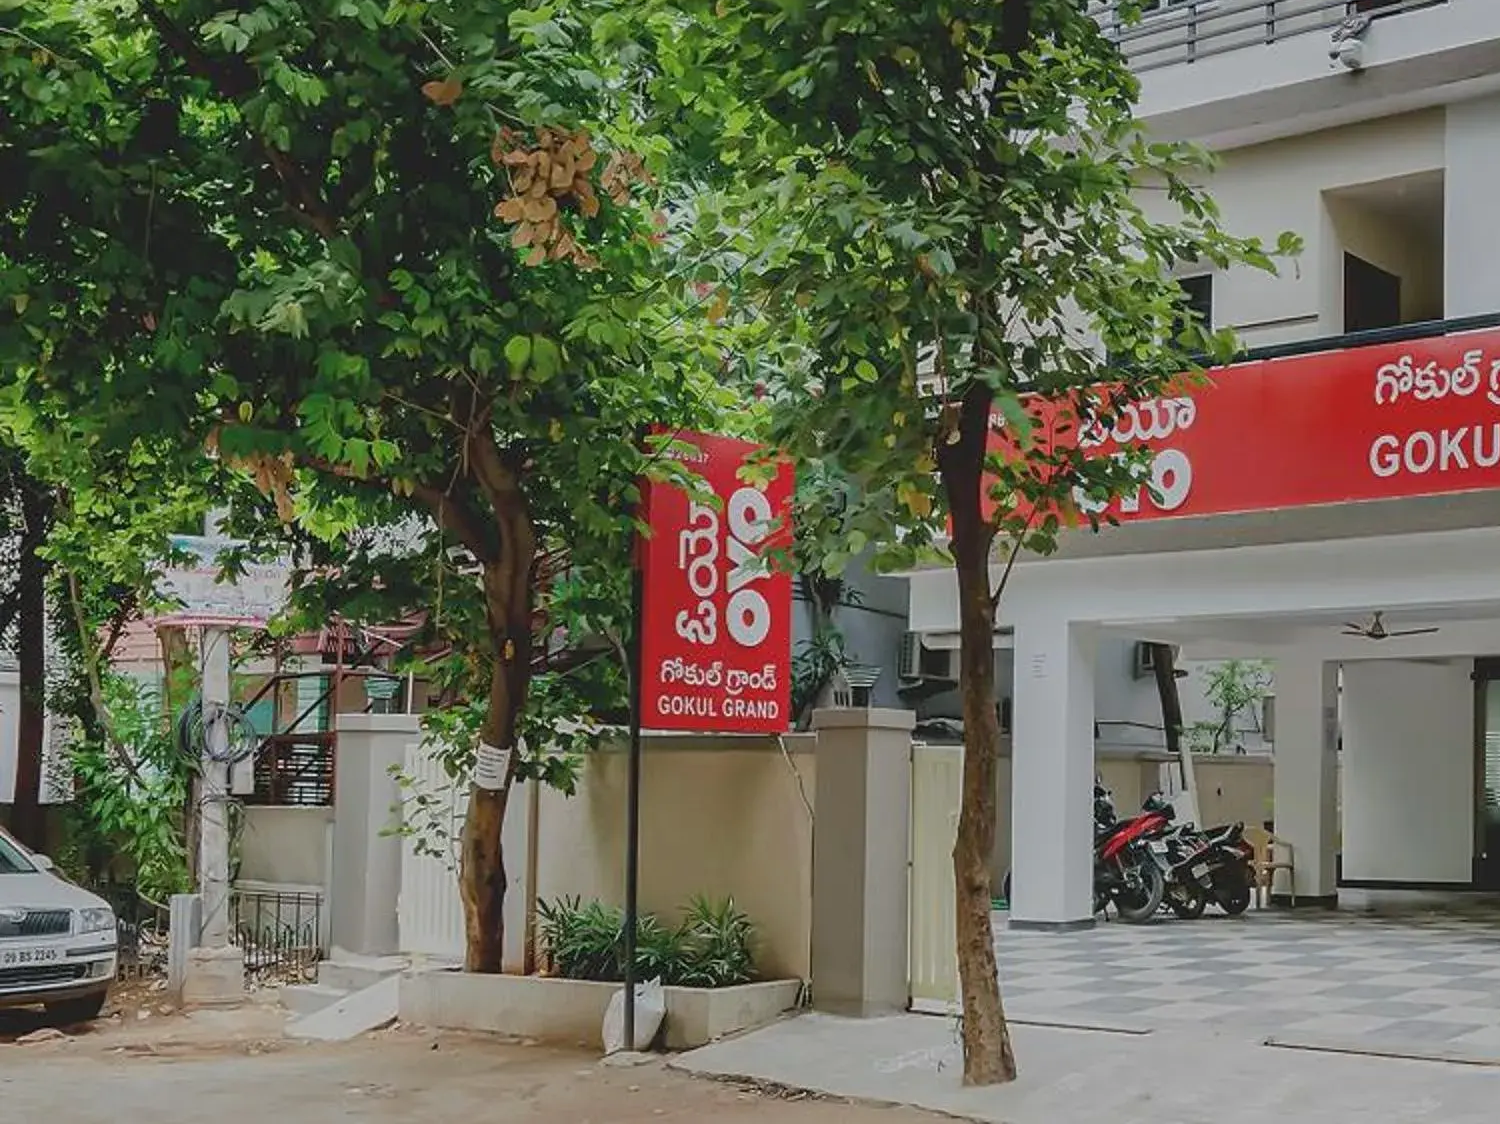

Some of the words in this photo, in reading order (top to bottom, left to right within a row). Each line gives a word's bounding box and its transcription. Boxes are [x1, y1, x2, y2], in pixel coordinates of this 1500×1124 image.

[1375, 349, 1483, 405] గోకుల్
[725, 486, 772, 647] OYO
[657, 694, 717, 717] GOKUL
[722, 696, 779, 719] GRAND
